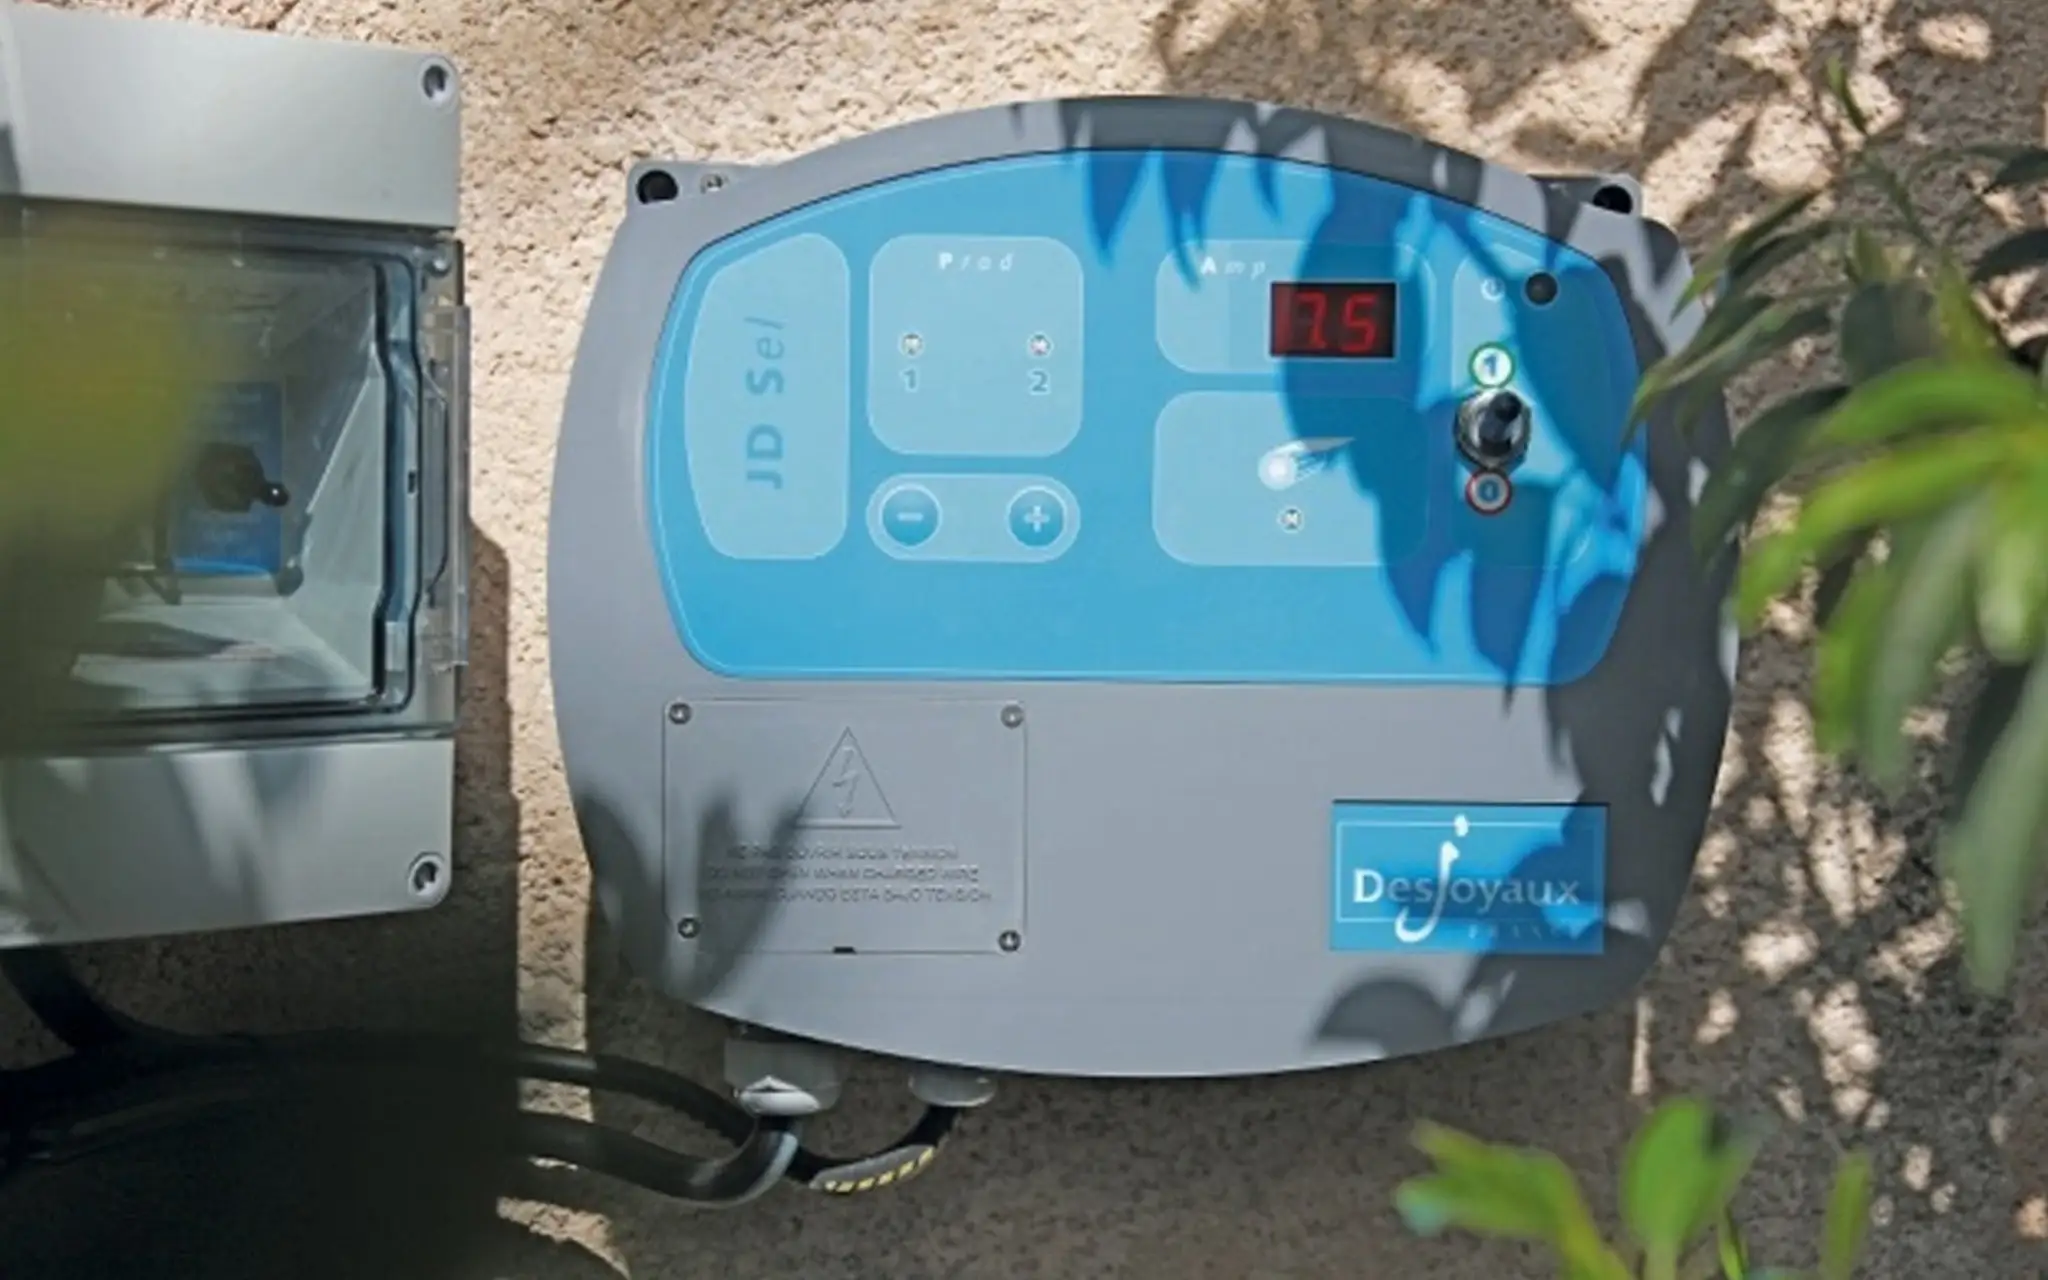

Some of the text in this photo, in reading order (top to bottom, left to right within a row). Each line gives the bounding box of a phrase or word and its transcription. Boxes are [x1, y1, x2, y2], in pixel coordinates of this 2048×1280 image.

[1200, 256, 1267, 280] Amp
[1483, 353, 1498, 378] 1
[903, 367, 917, 391] 1
[1030, 369, 1049, 394] 2
[744, 316, 785, 490] JD Sel
